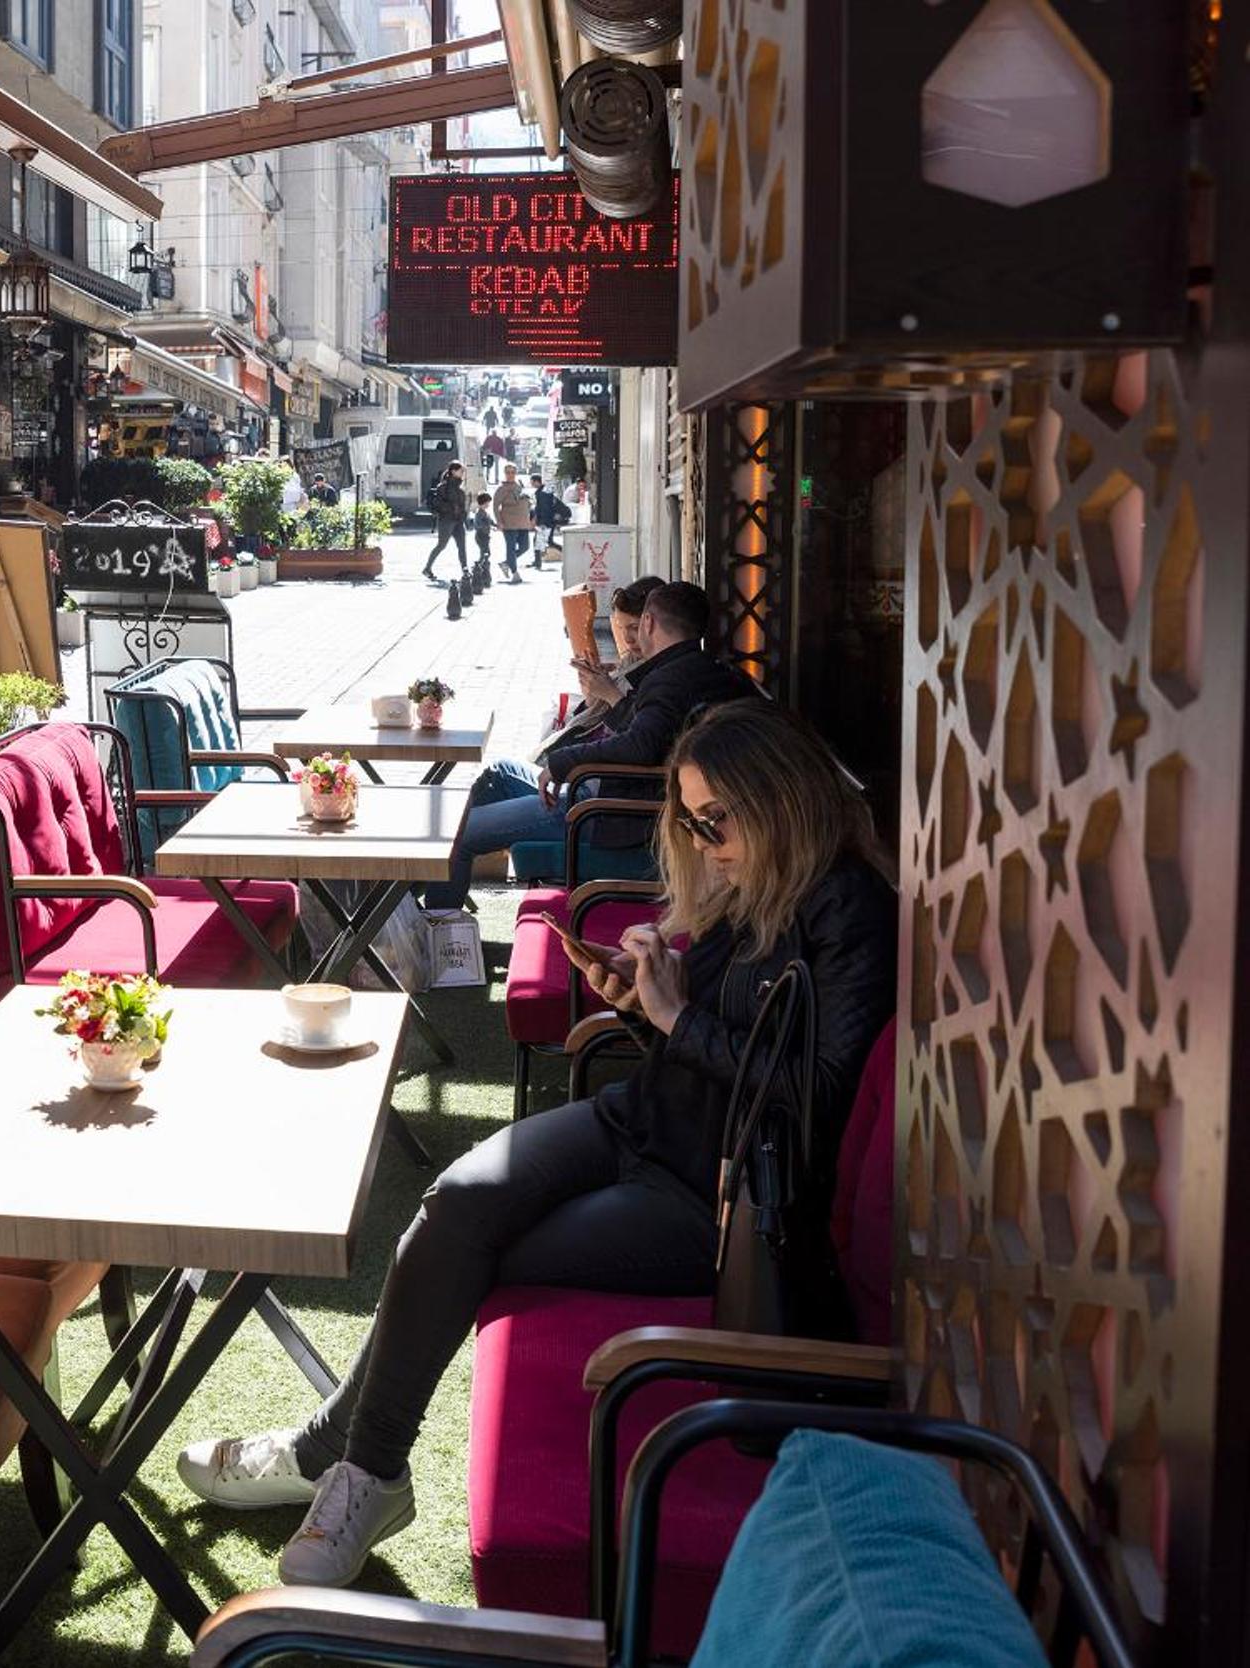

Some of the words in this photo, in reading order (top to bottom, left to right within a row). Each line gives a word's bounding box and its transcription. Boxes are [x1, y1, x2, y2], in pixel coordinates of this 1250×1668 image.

[446, 194, 518, 222] OLD
[530, 193, 607, 221] CIT
[411, 223, 654, 254] RESTAURANT
[577, 383, 603, 395] NO
[74, 547, 151, 577] 2019
